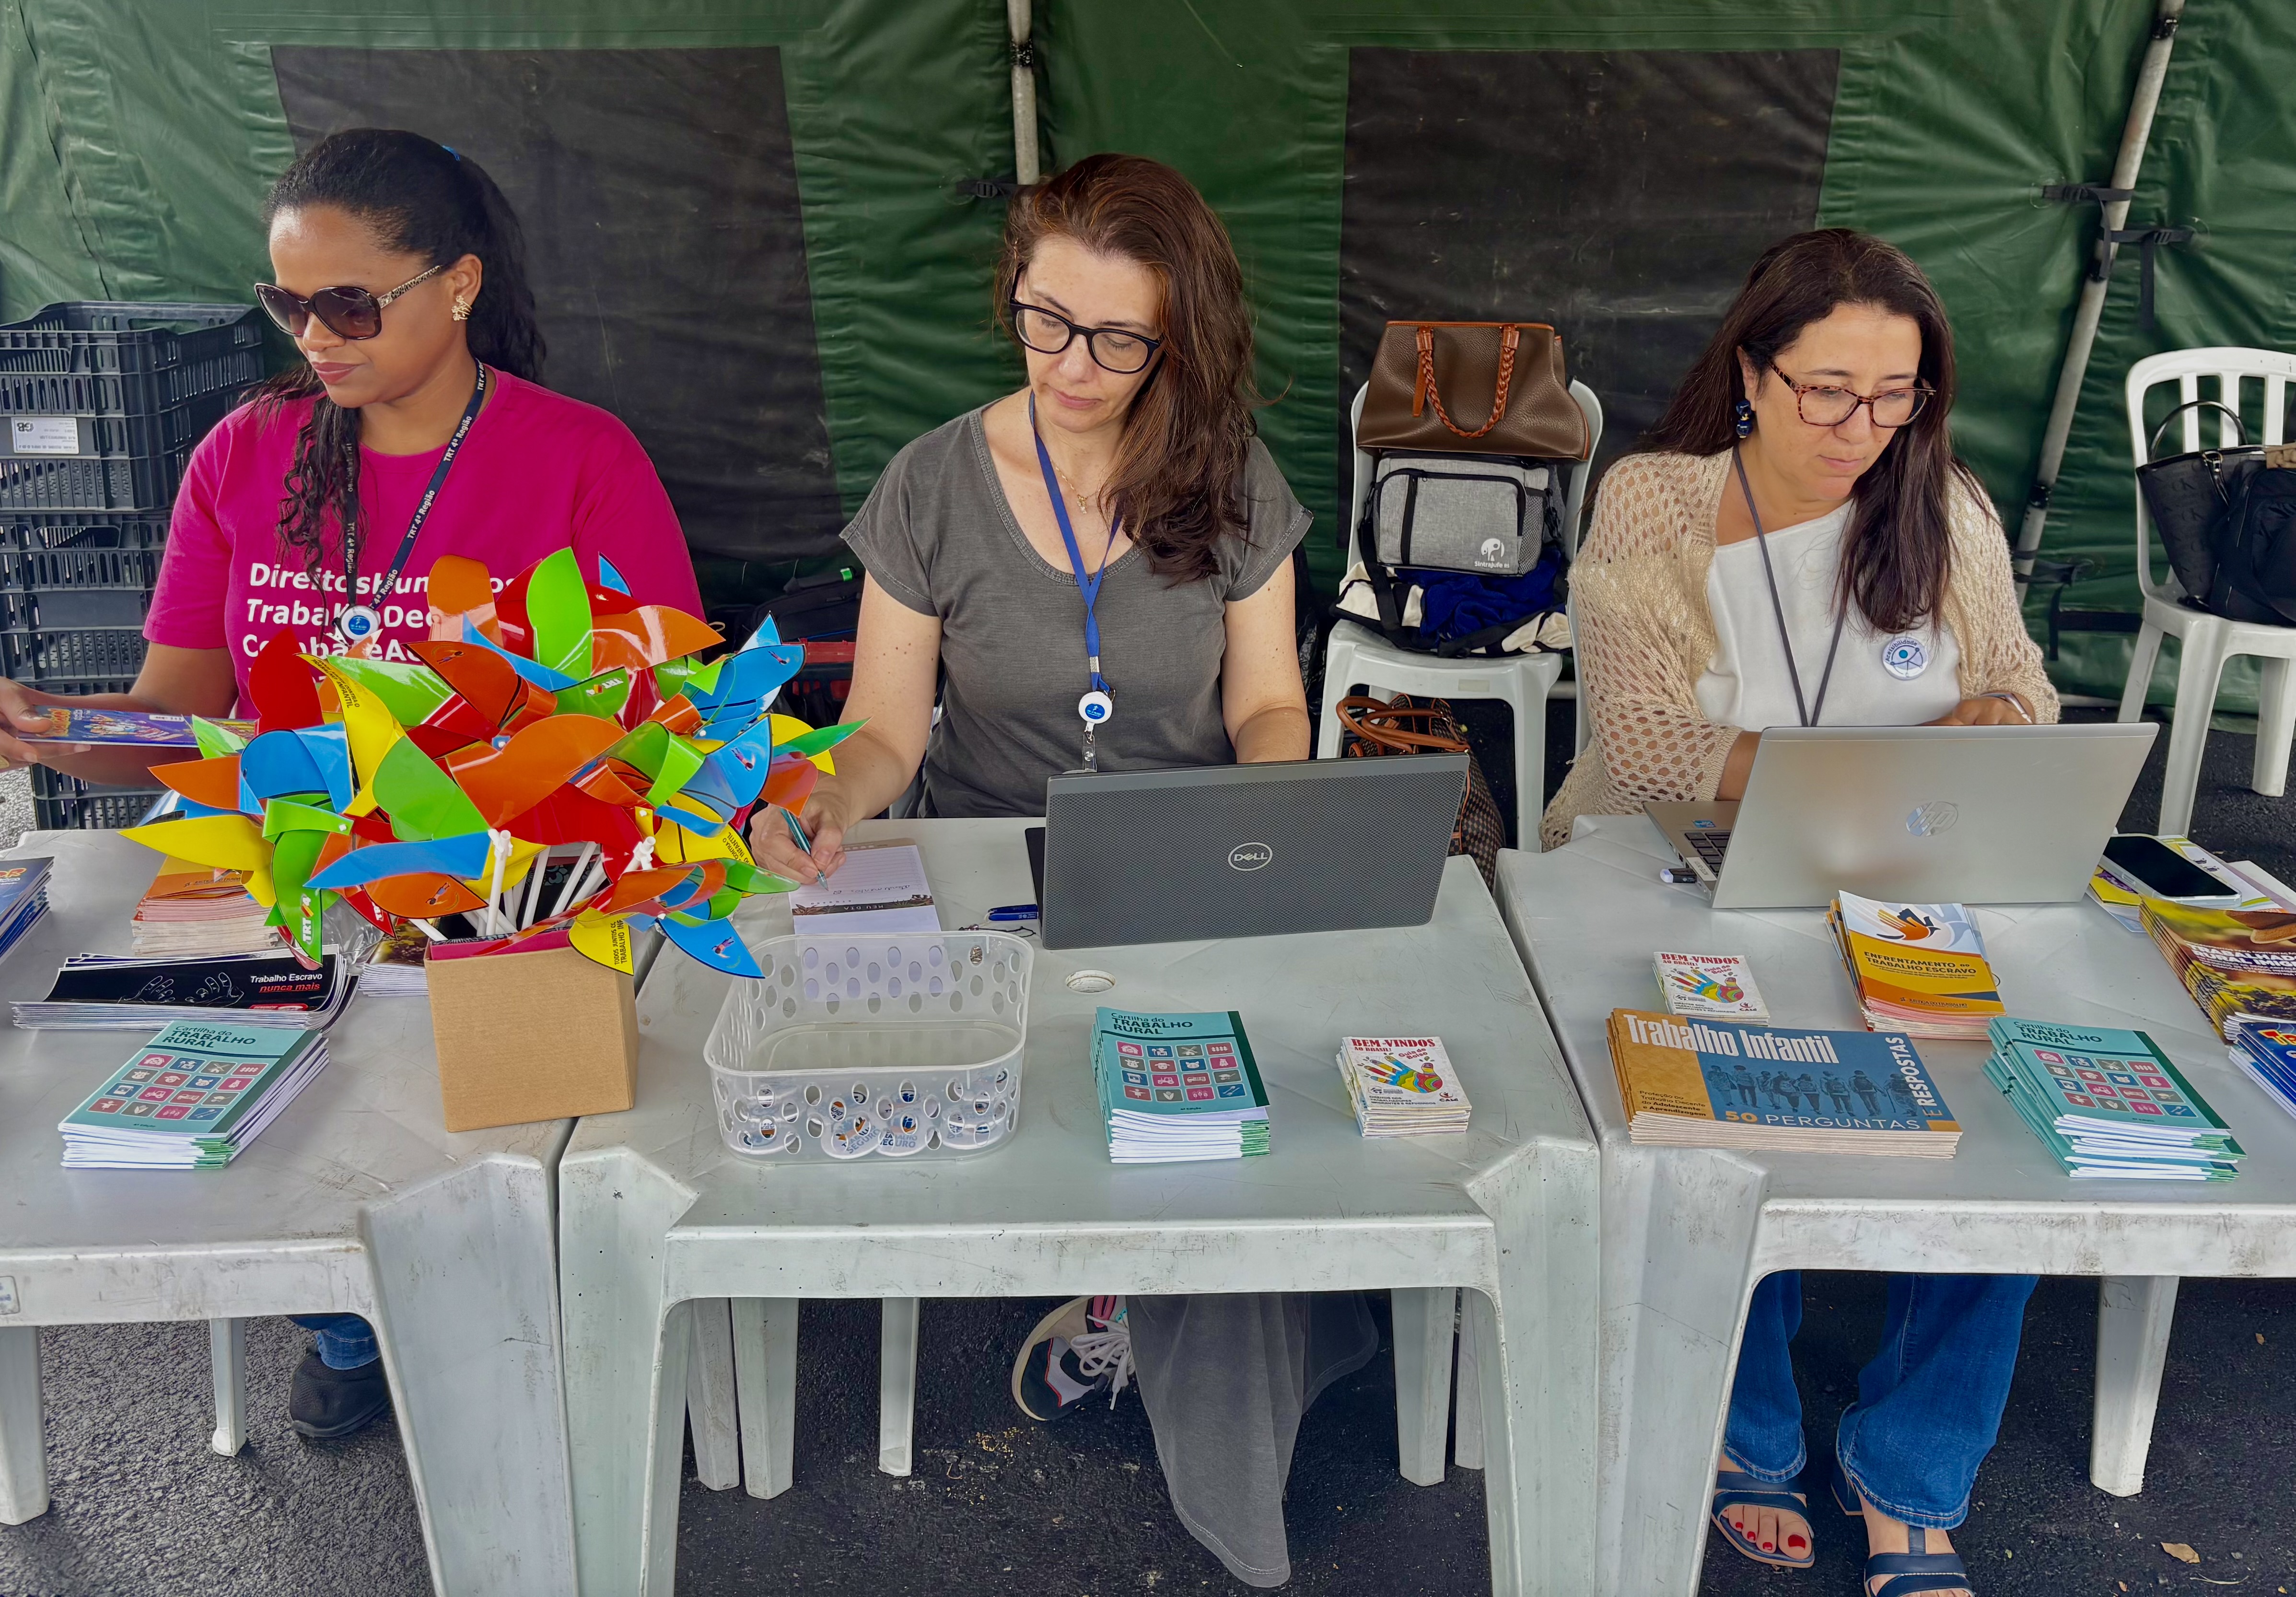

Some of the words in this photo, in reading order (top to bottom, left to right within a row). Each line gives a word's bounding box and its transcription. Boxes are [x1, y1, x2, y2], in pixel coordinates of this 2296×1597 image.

[443, 447, 455, 462] TRT
[456, 415, 472, 438] Região
[407, 524, 418, 539] TRT
[419, 490, 435, 515] Região
[380, 569, 398, 596] Região
[336, 681, 354, 708] INFANTIL
[344, 683, 358, 703] CONTRA
[727, 832, 745, 858] INFANTIL
[1234, 852, 1268, 861] DELL
[302, 897, 311, 906] 4
[302, 917, 312, 941] TRT
[618, 932, 627, 964] TRABALHO
[1864, 951, 1956, 968] ENFRENTAMENTO
[2191, 949, 2253, 964] RURAL
[1865, 956, 1923, 971] TRABALHO
[1925, 965, 1977, 974] ESCRAVO
[250, 975, 287, 983] Trabalho
[295, 982, 320, 991] mais
[1111, 1012, 1149, 1022] Cartilha
[1111, 1017, 1193, 1028] TRABALHO
[175, 1025, 216, 1034] Cartilha
[1113, 1023, 1163, 1034] RURAL
[2014, 1021, 2053, 1032] Cartilha
[171, 1030, 256, 1045] TRABALHO
[1623, 1014, 1739, 1057] Trabalho
[1739, 1029, 1840, 1064] Infantil
[2016, 1025, 2102, 1043] TRABALHO
[2021, 1032, 2075, 1045] RURAL
[162, 1036, 214, 1048] RURAL
[1885, 1036, 1938, 1107] RESPOSTAS
[1639, 1090, 1673, 1099] Proteção
[1641, 1095, 1674, 1103] Trabalho
[1649, 1105, 1707, 1117] Aprendizagem
[1653, 1102, 1701, 1111] Adolescente
[1922, 1109, 1943, 1117] E
[1725, 1110, 1758, 1123] 50
[1765, 1114, 1921, 1130] PERGUNTAS
